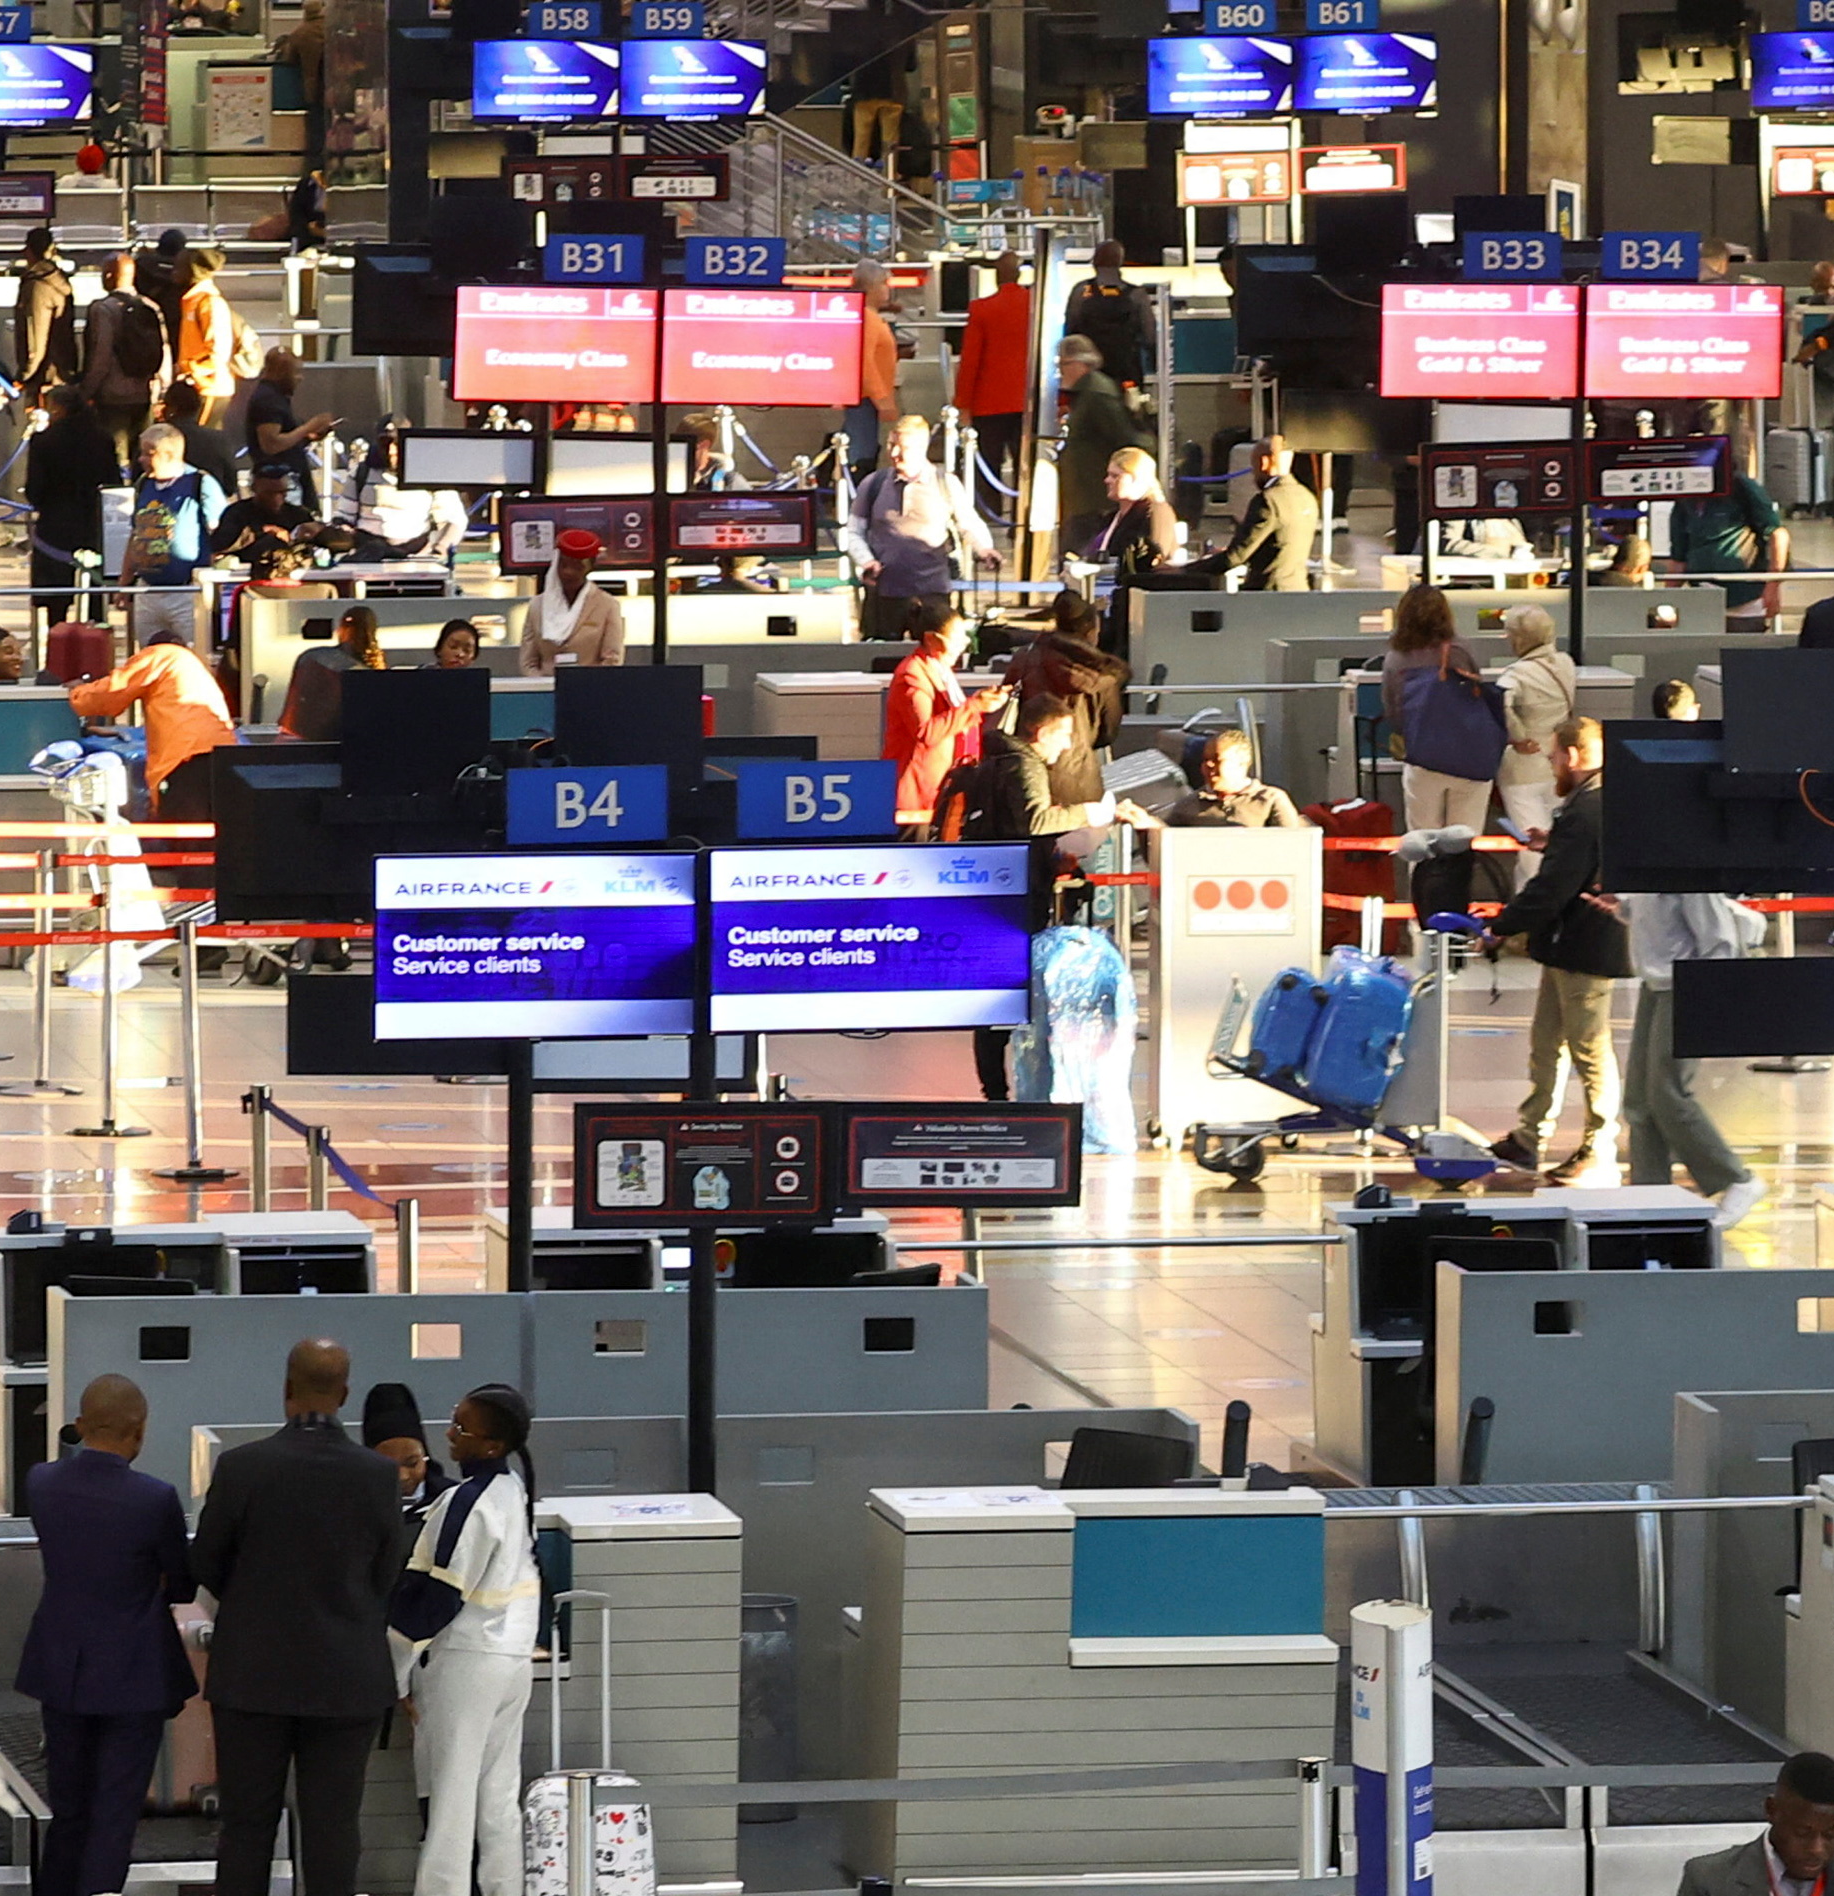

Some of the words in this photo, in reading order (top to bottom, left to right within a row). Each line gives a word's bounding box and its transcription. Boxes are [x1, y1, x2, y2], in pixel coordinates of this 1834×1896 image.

[543, 8, 589, 30] B58
[646, 8, 692, 30] B59
[1218, 5, 1264, 27] B60
[1320, 2, 1362, 24] B61
[563, 243, 622, 272] B31
[705, 246, 767, 275] B32
[1483, 240, 1545, 269] B33
[1621, 240, 1683, 269] B34
[486, 349, 575, 369] Economy
[576, 350, 628, 367] Class
[692, 352, 781, 372] Economy
[784, 354, 833, 370] Class
[556, 781, 623, 828] B4
[786, 775, 851, 822] B5
[395, 880, 531, 896] AIRFRANCE
[730, 871, 867, 888] AIRFRANCE
[937, 868, 990, 886] KLM
[393, 935, 500, 952] Customer
[506, 933, 585, 951] service
[728, 927, 836, 944] Customer
[840, 924, 919, 942] service
[393, 957, 470, 975] Service
[474, 956, 541, 973] clients
[728, 949, 804, 967] Service
[809, 948, 876, 965] clients
